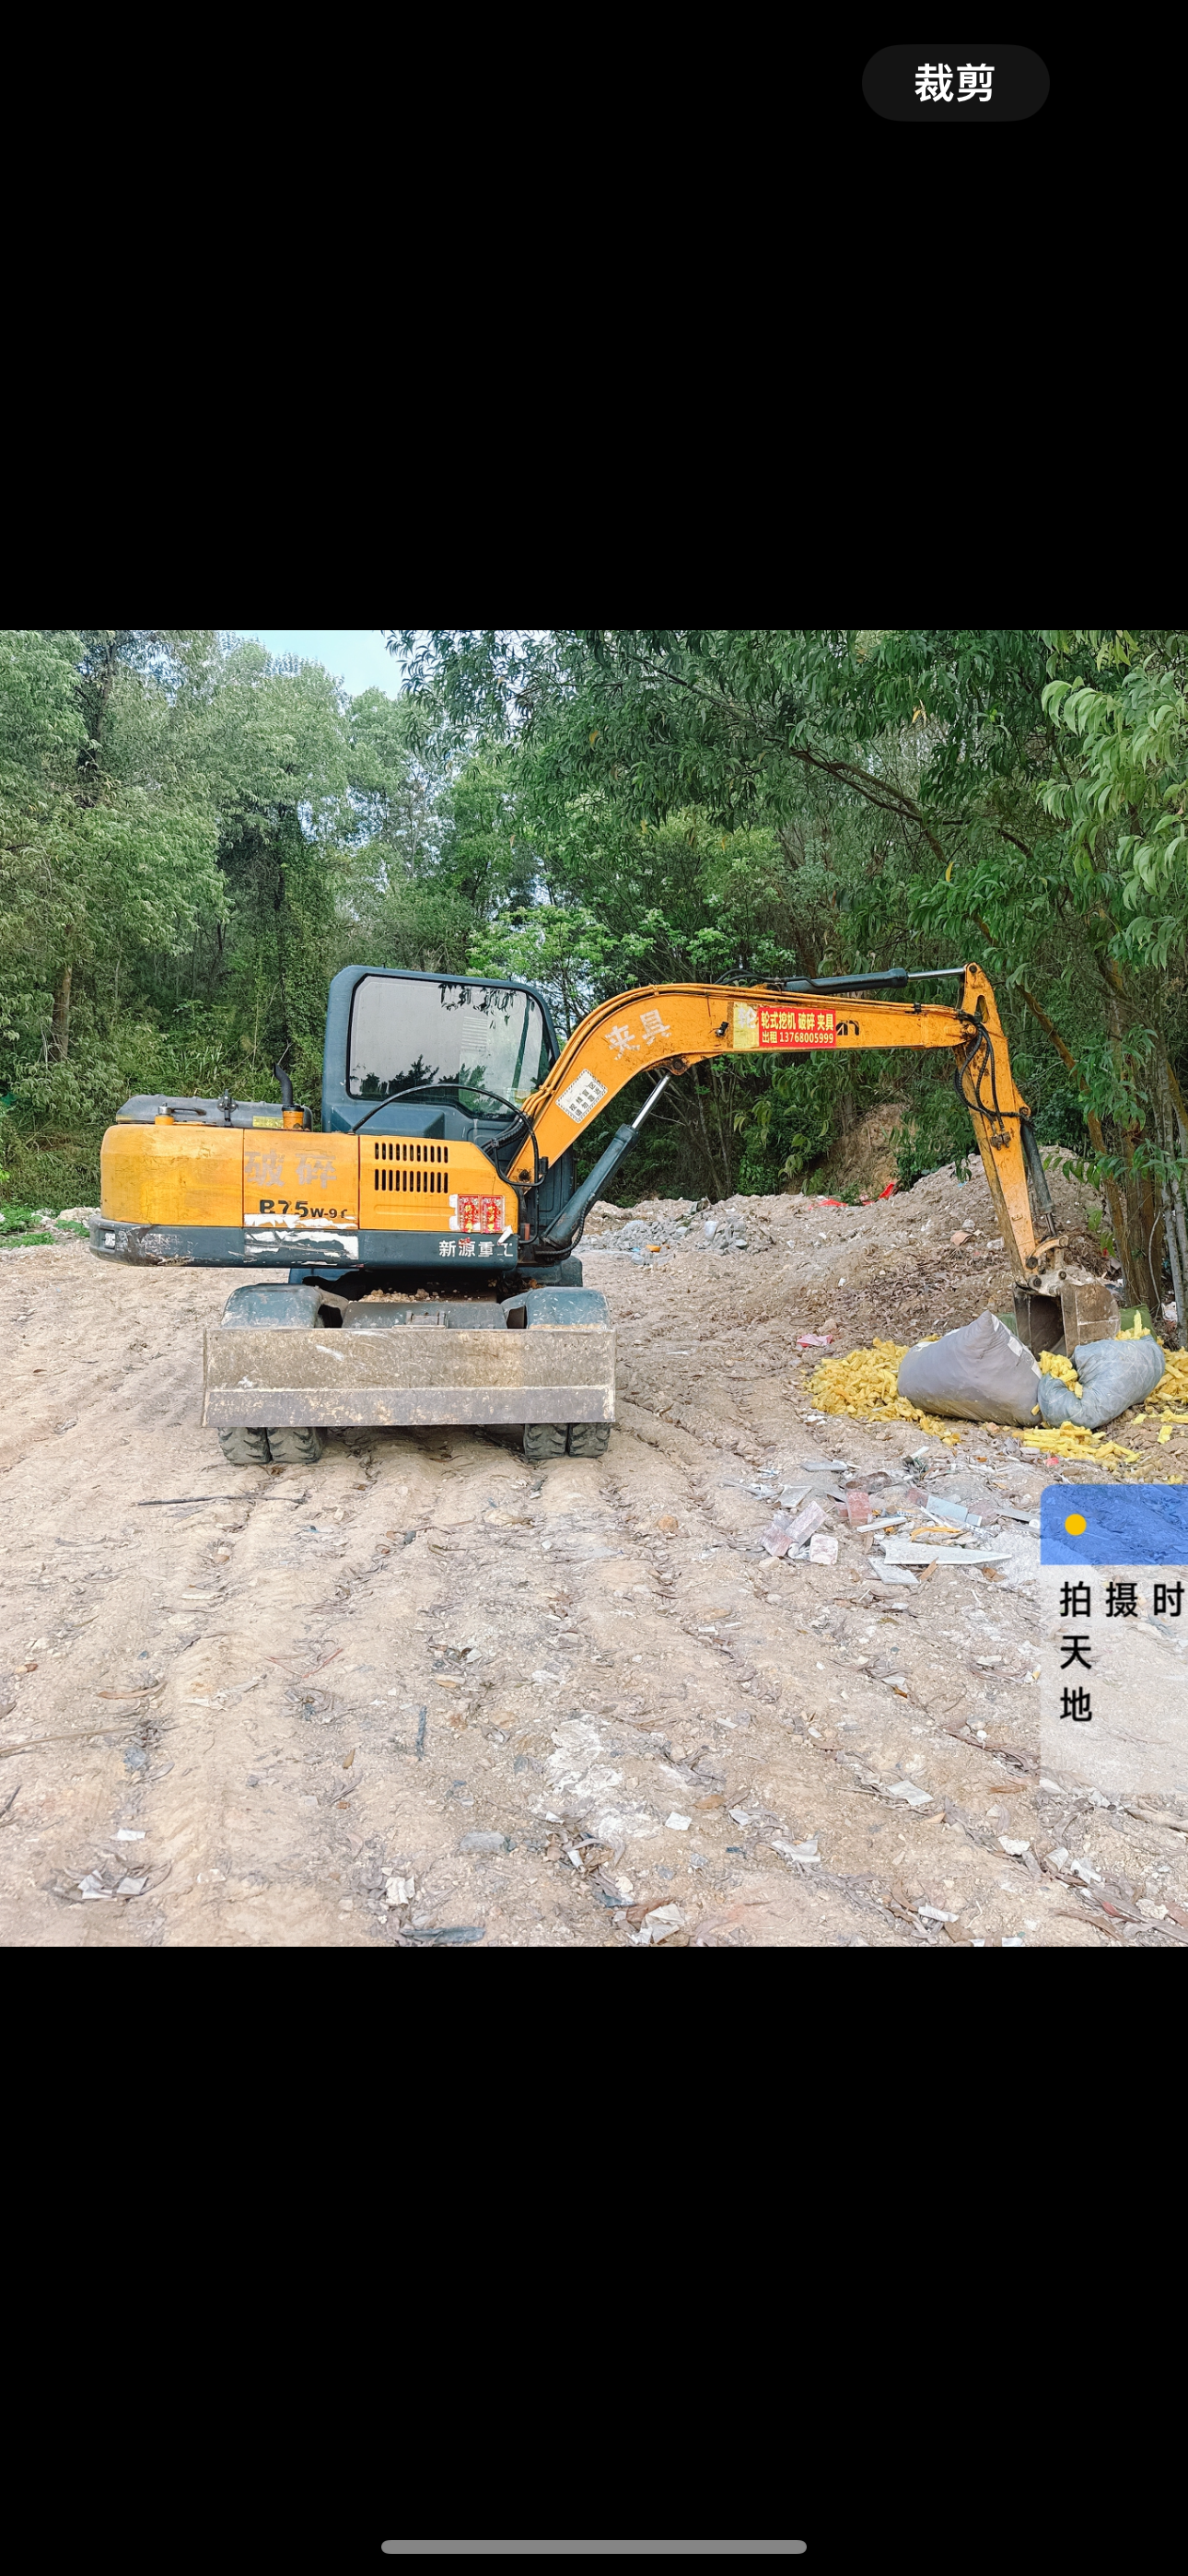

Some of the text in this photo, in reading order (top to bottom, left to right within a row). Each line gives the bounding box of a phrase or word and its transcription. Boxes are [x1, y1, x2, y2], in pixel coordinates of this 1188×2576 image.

[604, 1009, 671, 1060] 夹具
[761, 1012, 796, 1030] 轮式挖机
[798, 1013, 815, 1030] 破碎
[817, 1013, 833, 1030] 夹具
[762, 1030, 777, 1044] 出租
[779, 1031, 833, 1044] 13768005999
[244, 1149, 337, 1189] 破碎
